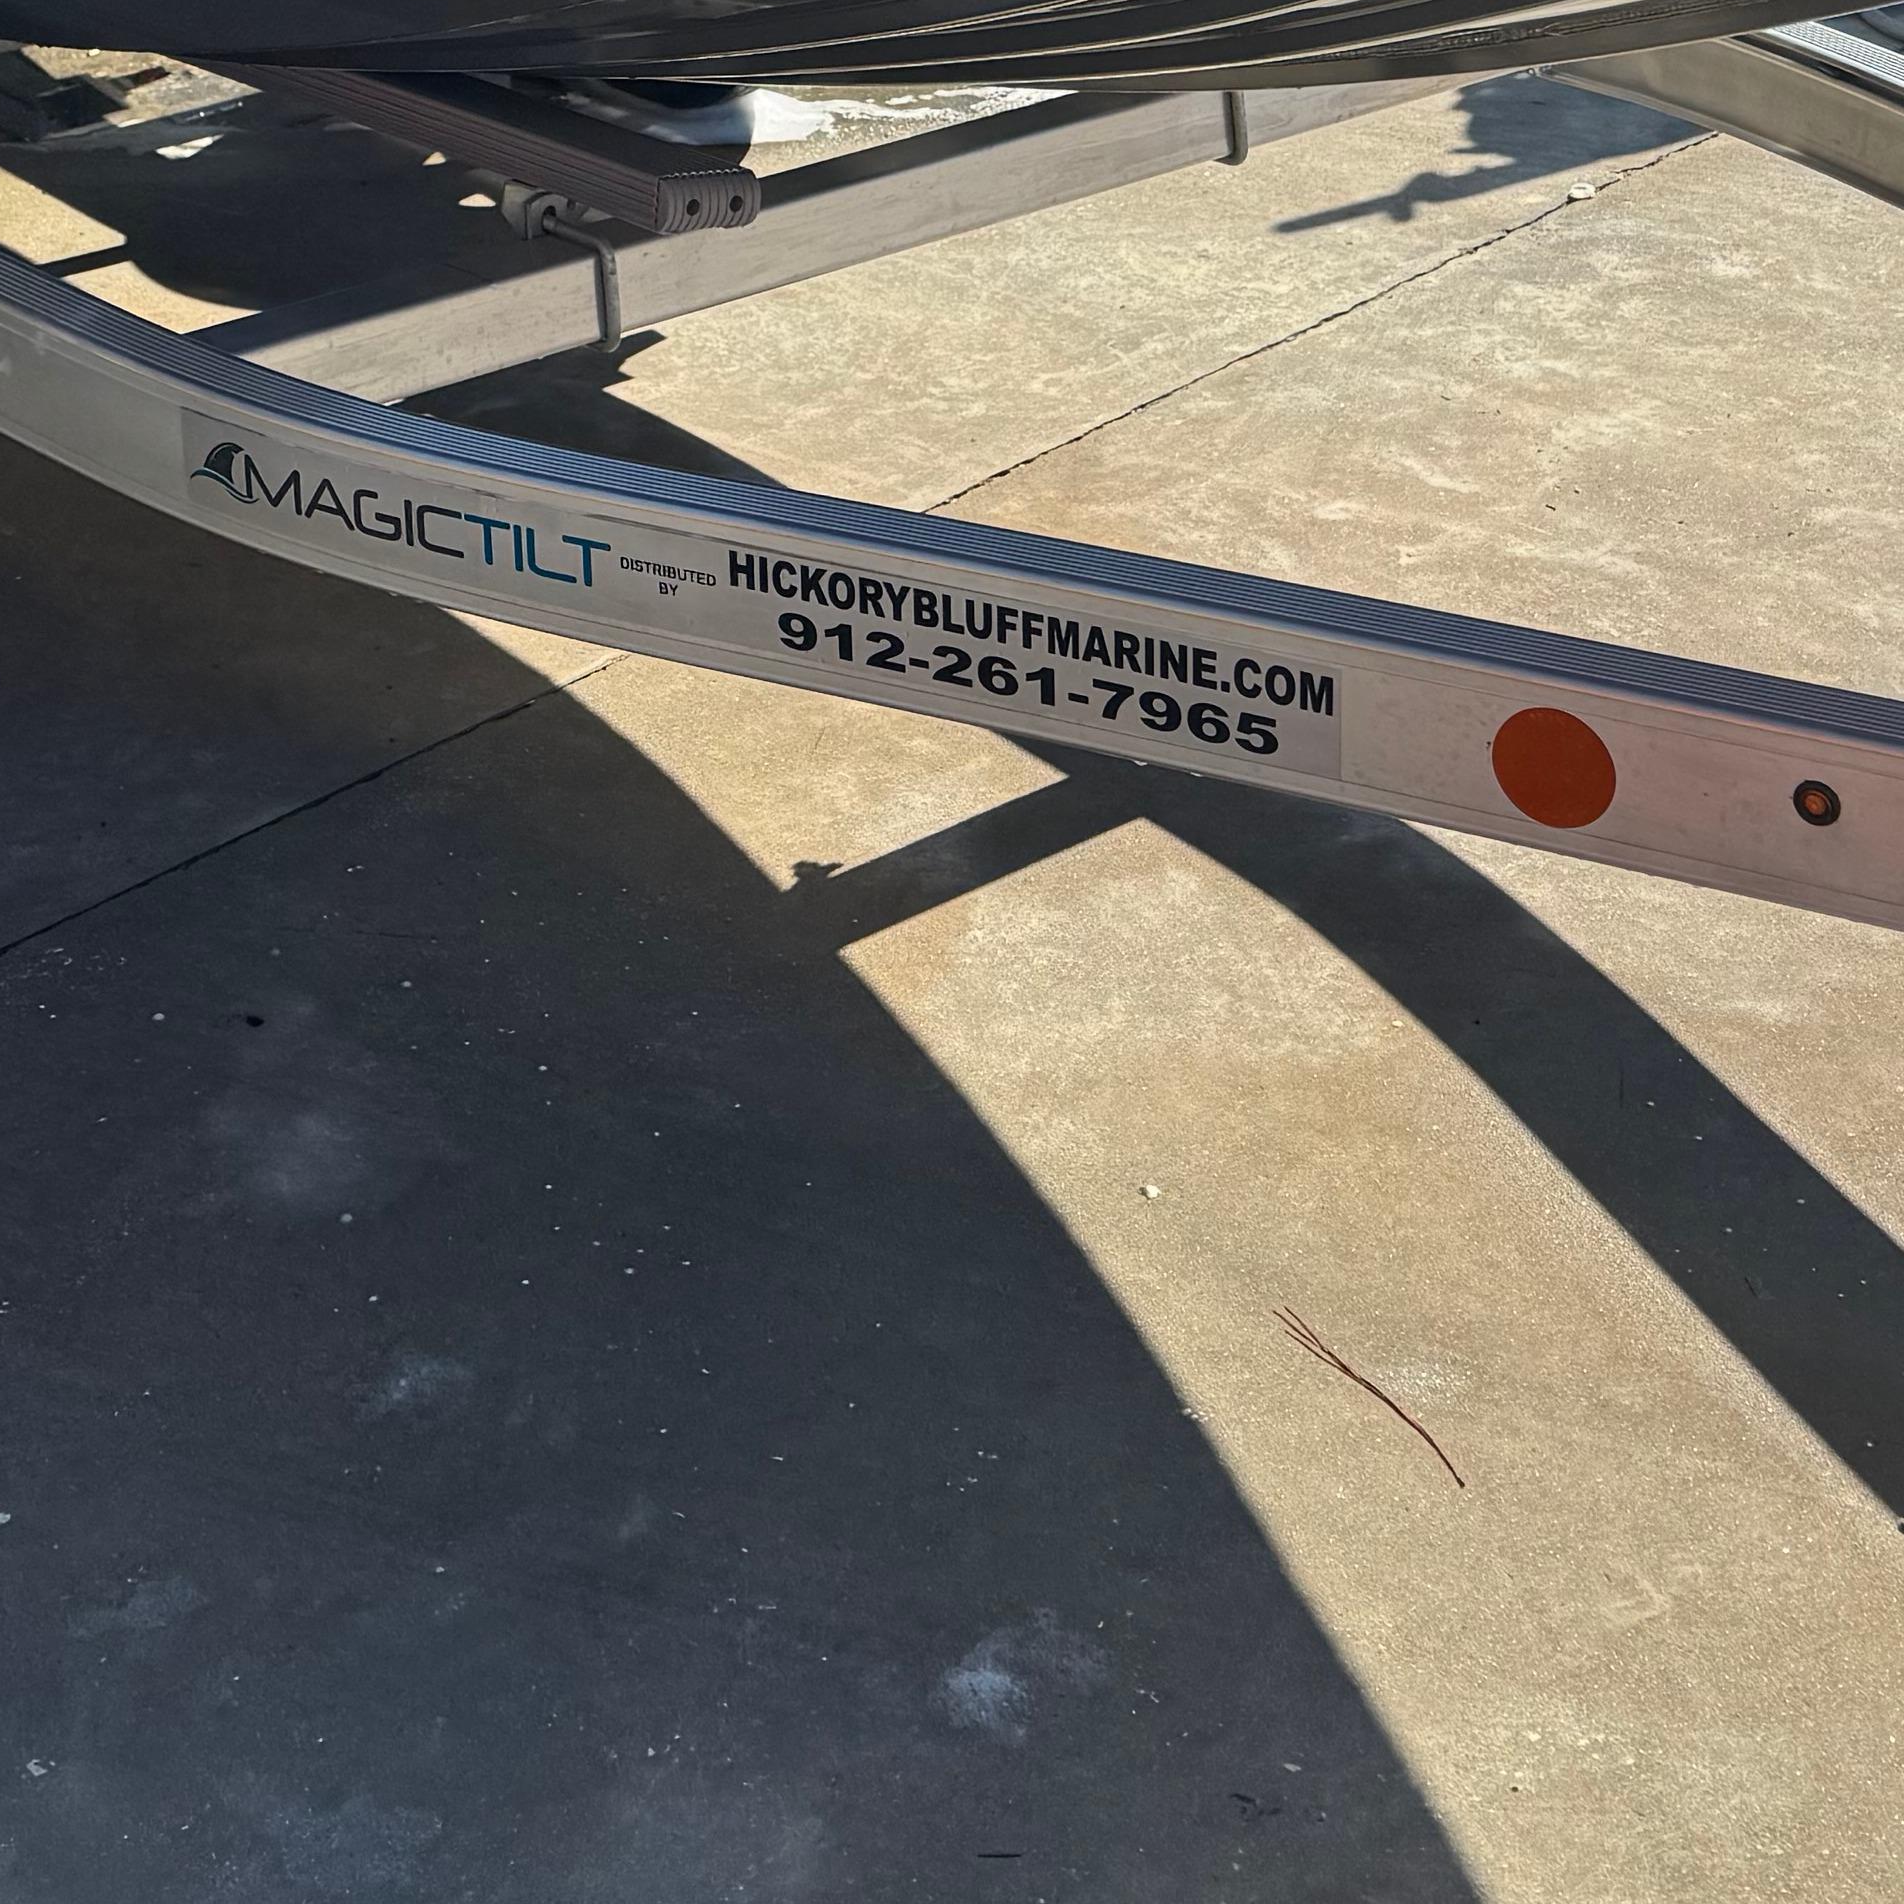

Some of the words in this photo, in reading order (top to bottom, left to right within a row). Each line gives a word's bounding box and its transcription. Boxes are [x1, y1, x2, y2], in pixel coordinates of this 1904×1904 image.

[240, 453, 611, 588] MAGICTILT
[620, 556, 717, 587] DISTRIBUTED
[659, 581, 678, 597] BY
[728, 549, 1335, 717] HICKORYBLUFFMARINE.COM
[776, 611, 1280, 756] 912-261-7965
